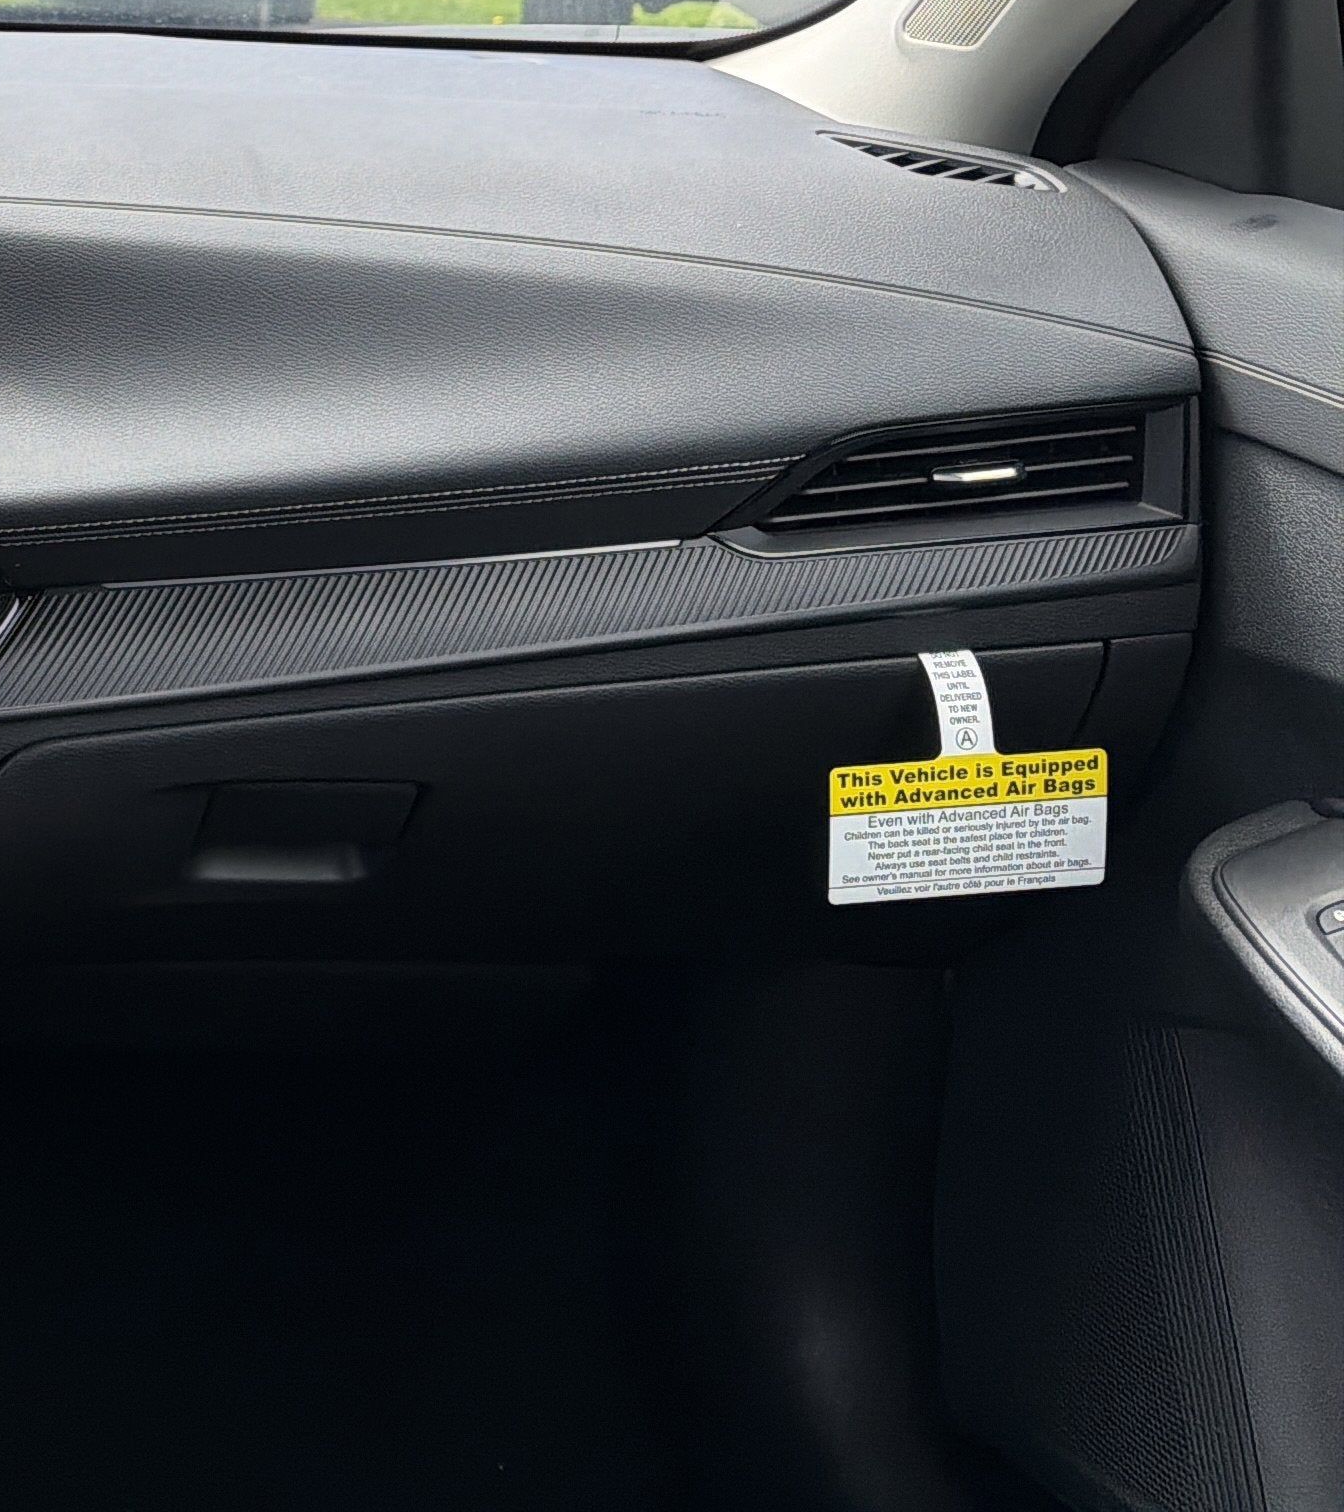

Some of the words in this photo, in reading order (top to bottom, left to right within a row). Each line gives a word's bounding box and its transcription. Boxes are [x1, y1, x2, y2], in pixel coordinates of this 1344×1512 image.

[961, 730, 974, 746] A
[837, 772, 882, 788] This
[889, 765, 968, 785] Vehicle
[976, 763, 993, 778] is
[1001, 755, 1098, 778] Equipped
[840, 791, 886, 808] with
[894, 782, 998, 804] Advanced
[1006, 781, 1037, 797] Air
[1044, 778, 1095, 795] Bags
[868, 815, 902, 828] Even
[907, 813, 934, 826] with
[938, 805, 1006, 823] Advanced
[1010, 805, 1030, 818] Air
[1034, 803, 1069, 818] Bags
[844, 831, 881, 841] Children
[884, 830, 900, 839] can
[903, 827, 914, 837] be
[917, 825, 940, 835] killed
[942, 826, 951, 834] or
[953, 822, 993, 833] seriously
[996, 819, 1026, 831] injured
[1029, 818, 1039, 829] by
[1042, 816, 1055, 826] the
[1058, 816, 1070, 825] air
[868, 840, 885, 850] The
[888, 838, 909, 849] back
[912, 837, 930, 847] seat
[933, 836, 940, 845] is
[943, 835, 957, 844] the
[989, 831, 1013, 841] place
[1016, 830, 1027, 838] for
[868, 851, 894, 861] Never
[897, 850, 911, 860] put
[972, 842, 993, 852] child
[996, 841, 1014, 851] seat
[1017, 841, 1025, 849] in
[1028, 839, 1042, 848] the
[875, 862, 907, 871] Always
[928, 858, 947, 866] seat
[973, 853, 990, 863] and
[993, 851, 1013, 862] child
[842, 875, 860, 884] See
[900, 869, 931, 879] manual
[934, 868, 946, 876] for
[949, 867, 972, 875] more
[974, 862, 1023, 874] information
[1026, 860, 1051, 870] about
[1054, 858, 1066, 867] air
[984, 879, 1004, 889] pour
